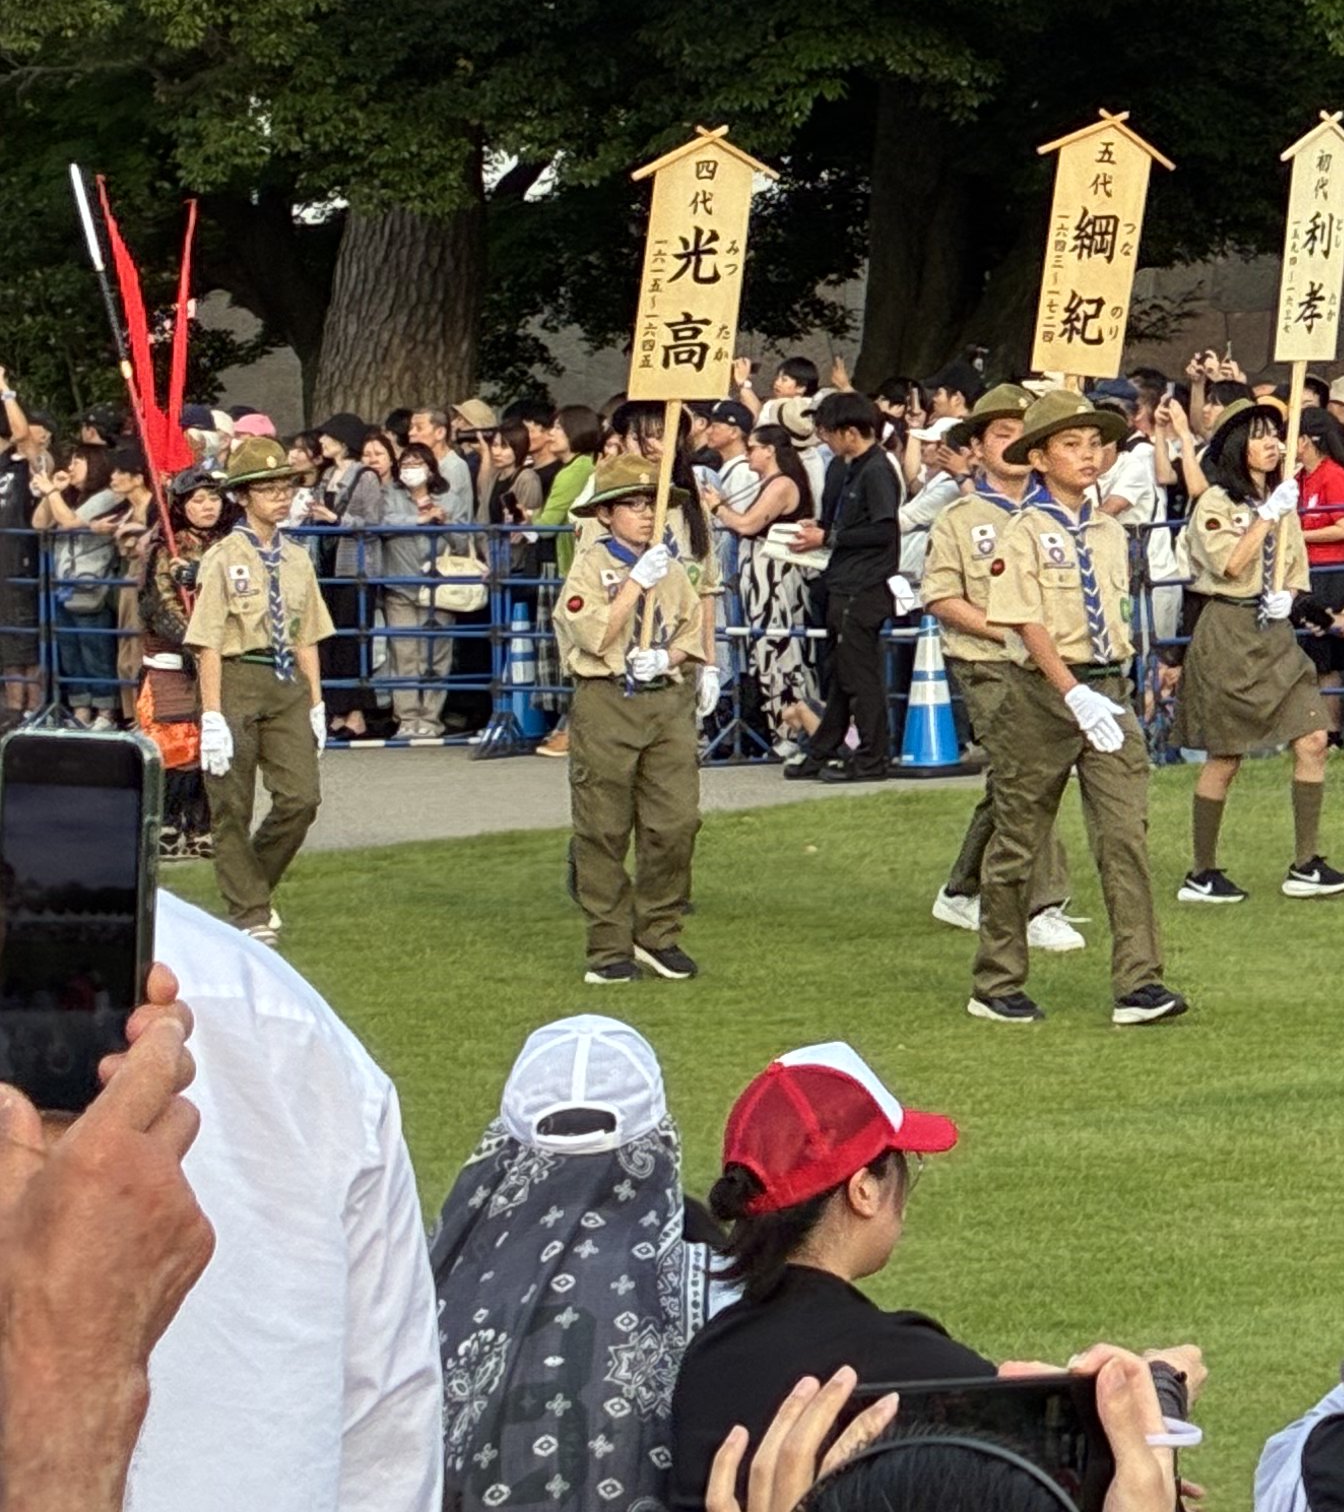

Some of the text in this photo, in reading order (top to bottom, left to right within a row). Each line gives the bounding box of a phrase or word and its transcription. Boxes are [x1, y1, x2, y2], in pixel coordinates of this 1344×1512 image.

[689, 159, 718, 216] 四代
[1090, 141, 1117, 198] 五代
[1314, 150, 1332, 201] 初代
[660, 225, 721, 373] 光高
[713, 240, 740, 362] みつ たか
[1058, 206, 1120, 346] 綱紀
[1107, 223, 1137, 341] つな のり
[1294, 211, 1334, 335] 利孝
